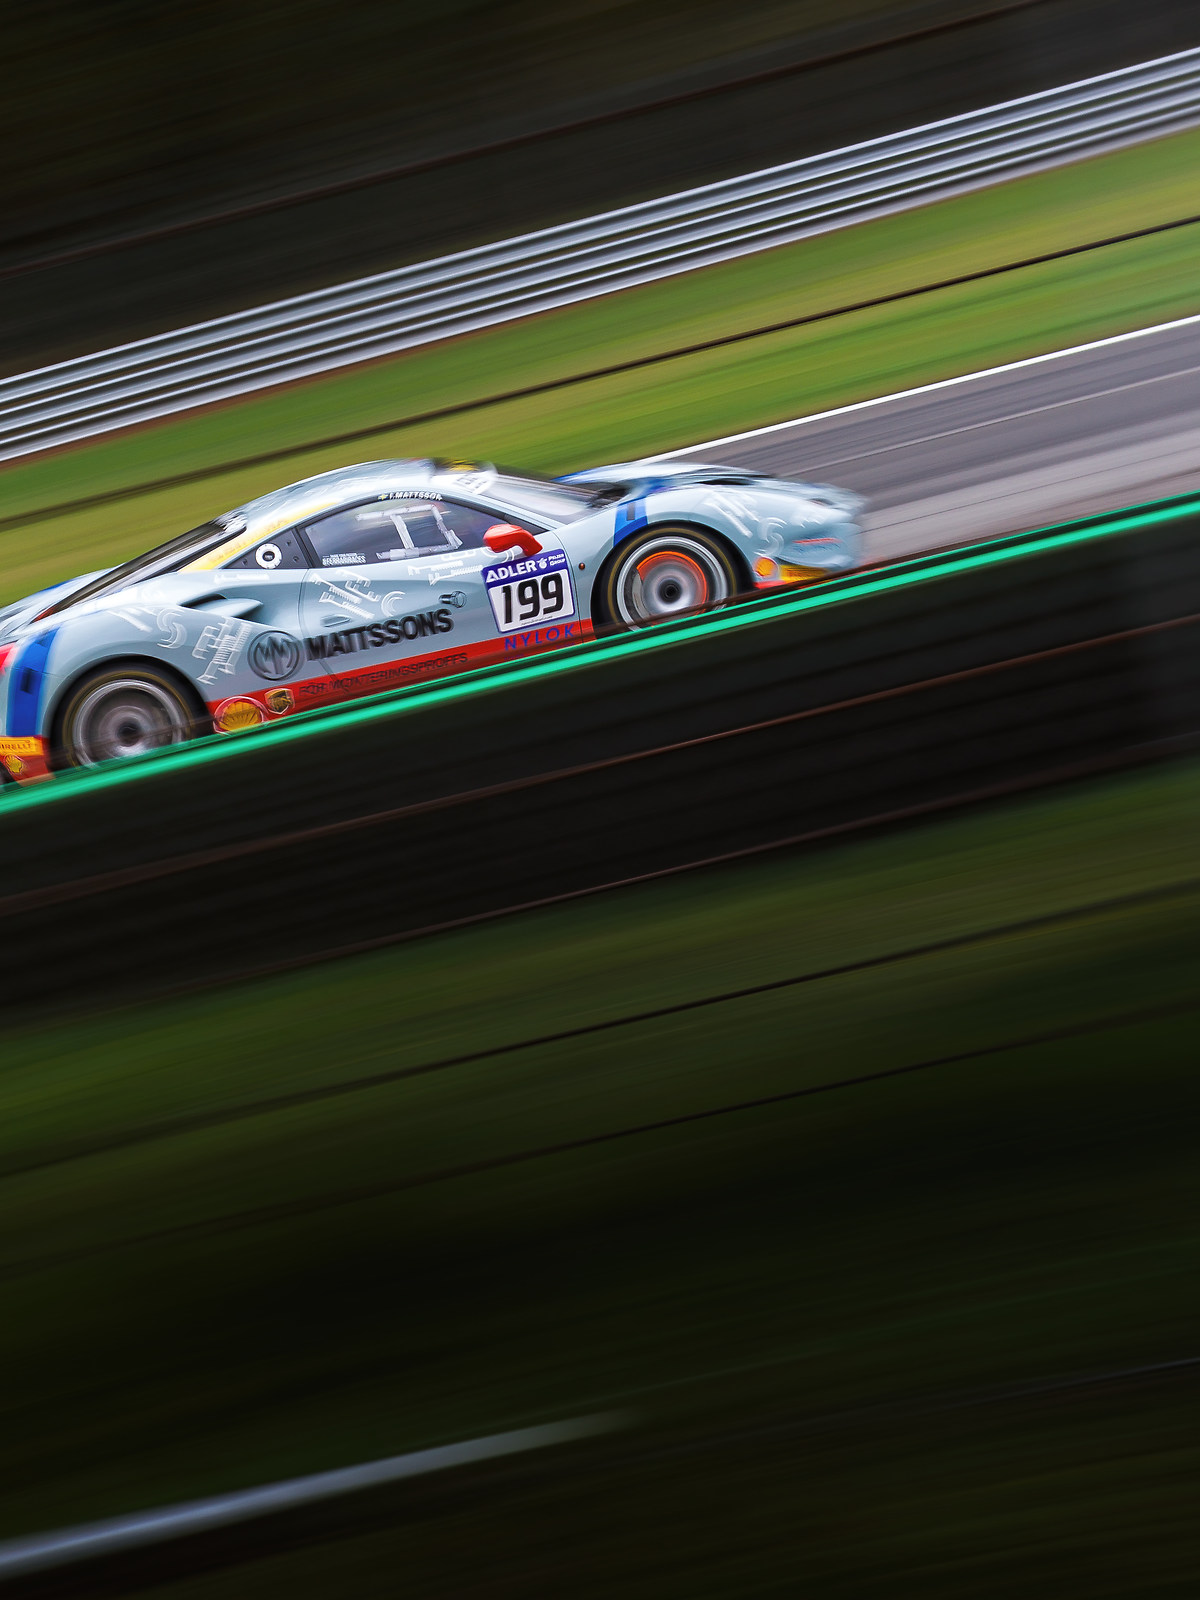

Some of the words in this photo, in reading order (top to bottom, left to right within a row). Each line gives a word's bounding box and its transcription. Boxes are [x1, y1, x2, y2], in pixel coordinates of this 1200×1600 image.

[486, 560, 538, 583] ADLER
[501, 572, 564, 625] 199
[303, 608, 455, 662] MATTSSONS
[504, 623, 575, 651] NYLOK
